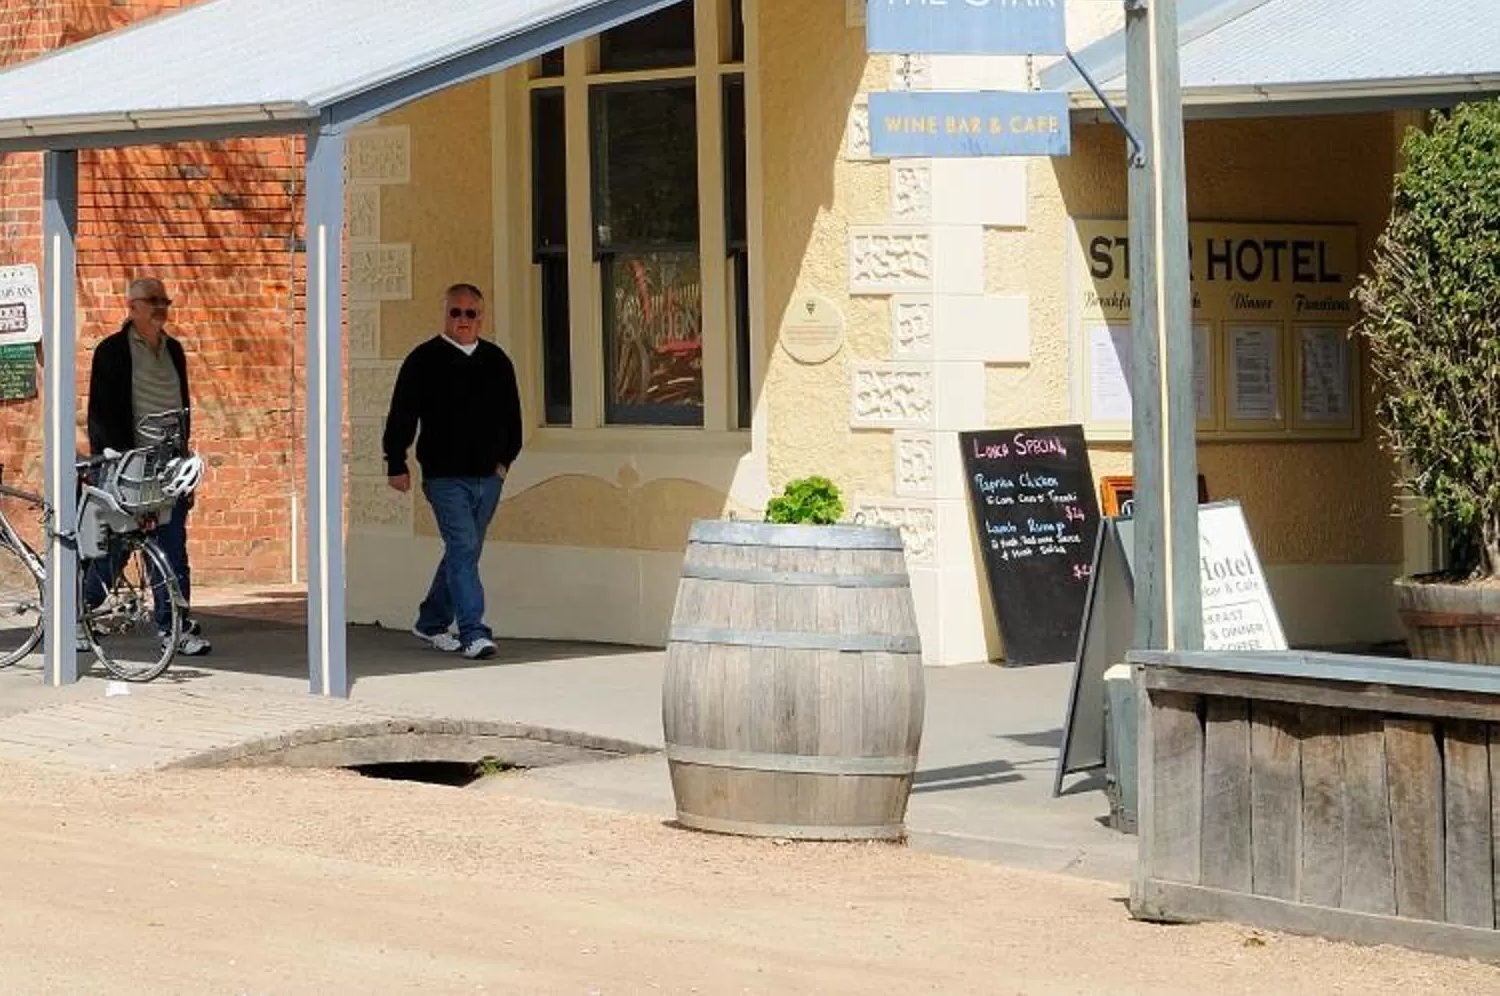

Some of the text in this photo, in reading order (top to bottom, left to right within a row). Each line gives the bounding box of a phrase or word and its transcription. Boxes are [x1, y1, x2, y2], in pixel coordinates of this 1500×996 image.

[885, 115, 1061, 135] WINE BAR & CAFE
[1206, 237, 1342, 284] HOTEL
[1027, 517, 1065, 537] Rump
